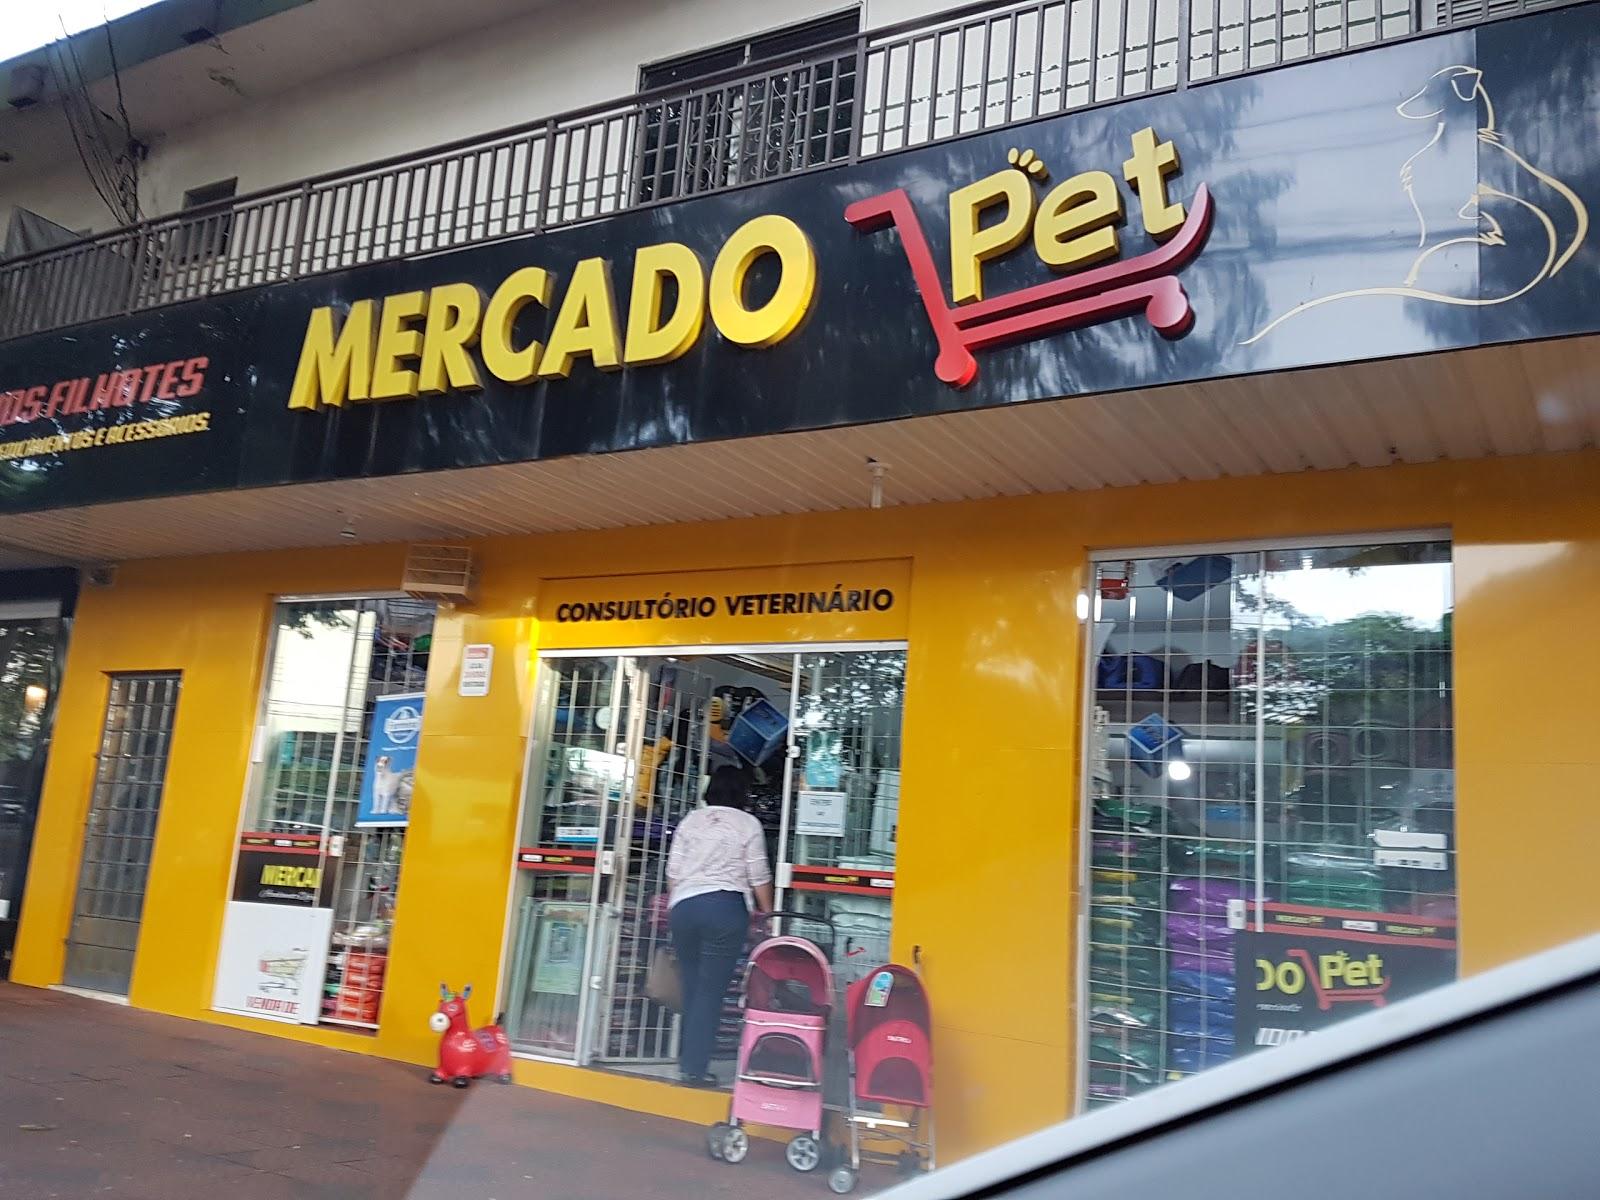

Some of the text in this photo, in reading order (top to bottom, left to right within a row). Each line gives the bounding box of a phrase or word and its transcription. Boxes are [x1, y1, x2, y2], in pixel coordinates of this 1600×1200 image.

[288, 127, 1188, 411] MERCADO Pet
[48, 356, 210, 417] FILHOTES
[557, 584, 894, 623] CONSULTÓRIO VETERINÁRIO
[1318, 953, 1384, 989] Pet
